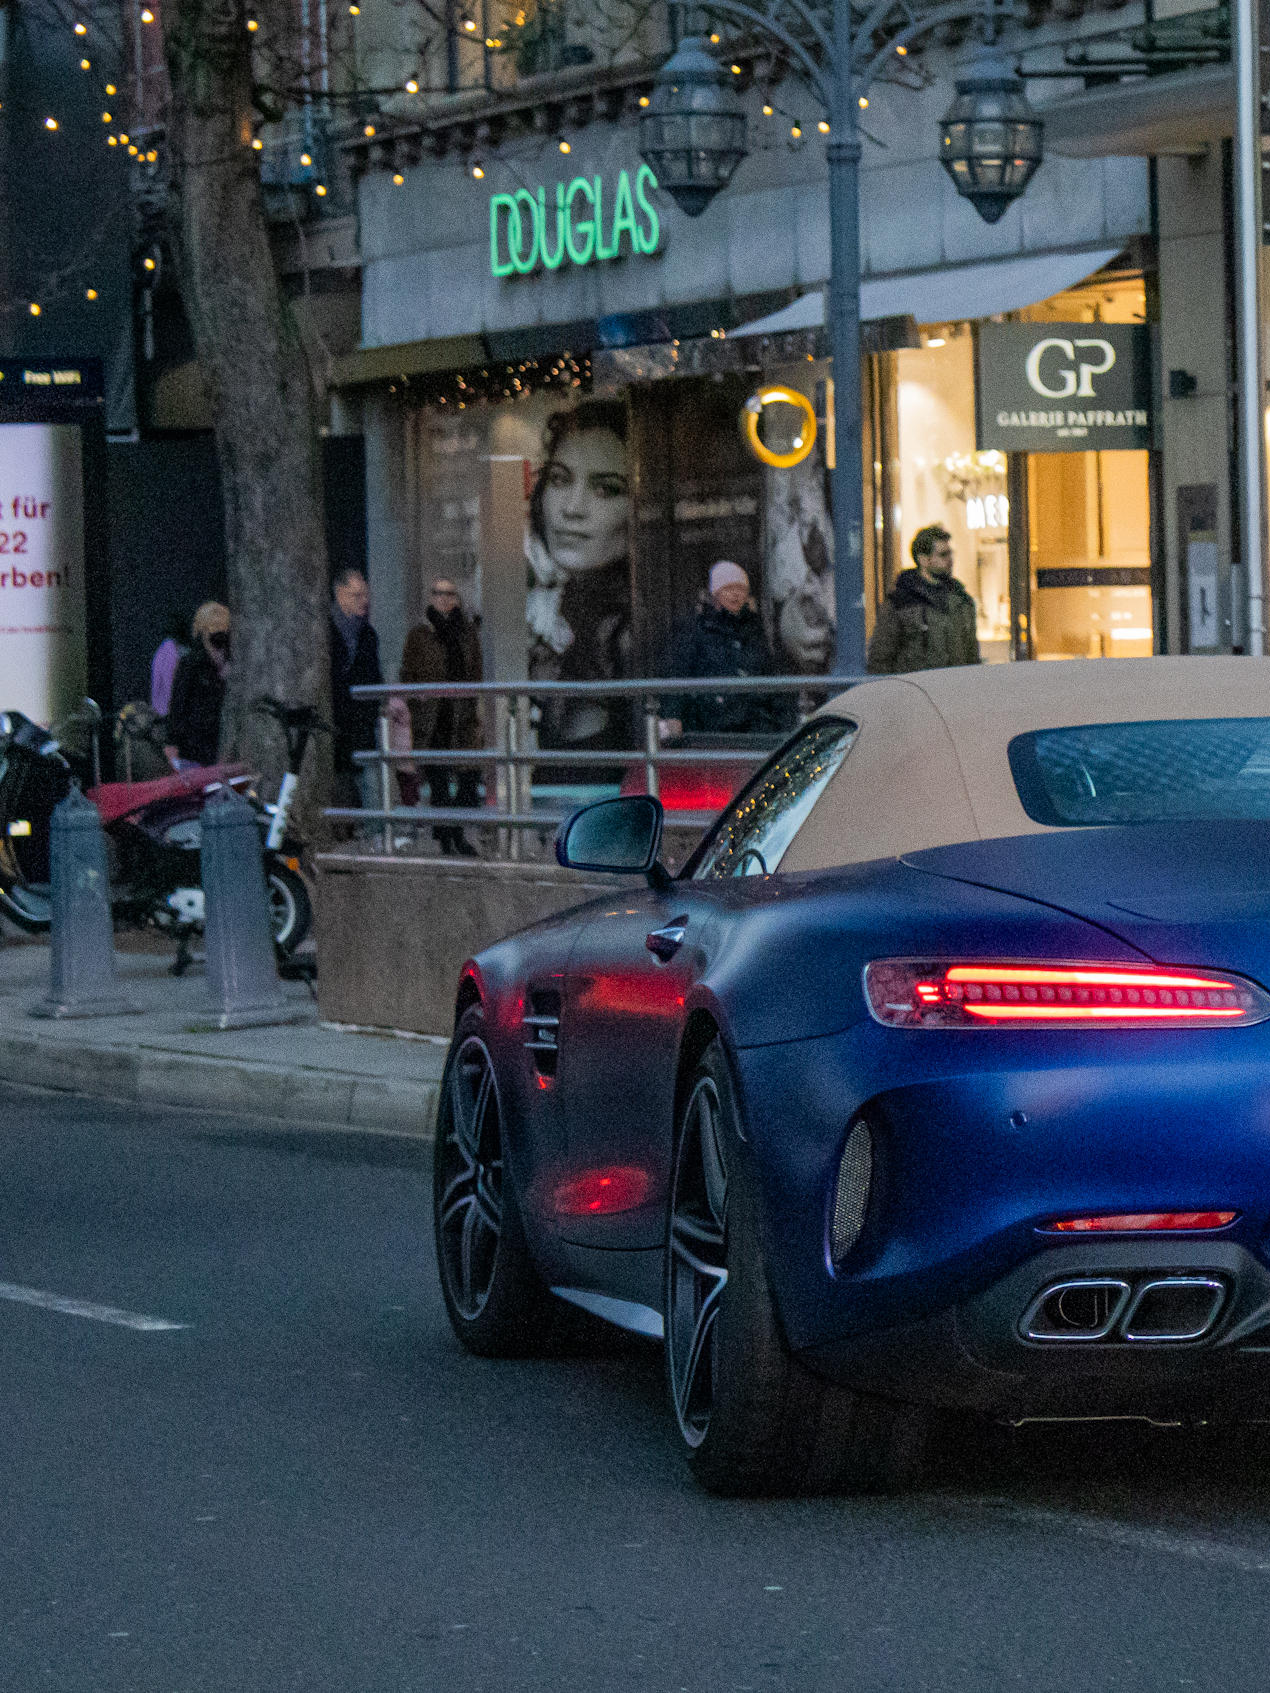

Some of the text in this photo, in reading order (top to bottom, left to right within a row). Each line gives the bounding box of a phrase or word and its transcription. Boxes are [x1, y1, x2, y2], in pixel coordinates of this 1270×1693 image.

[489, 163, 660, 277] DOUGLAS
[1026, 337, 1116, 398] GP
[996, 409, 1148, 428] GALERIE PAFFRATH
[12, 495, 50, 519] für
